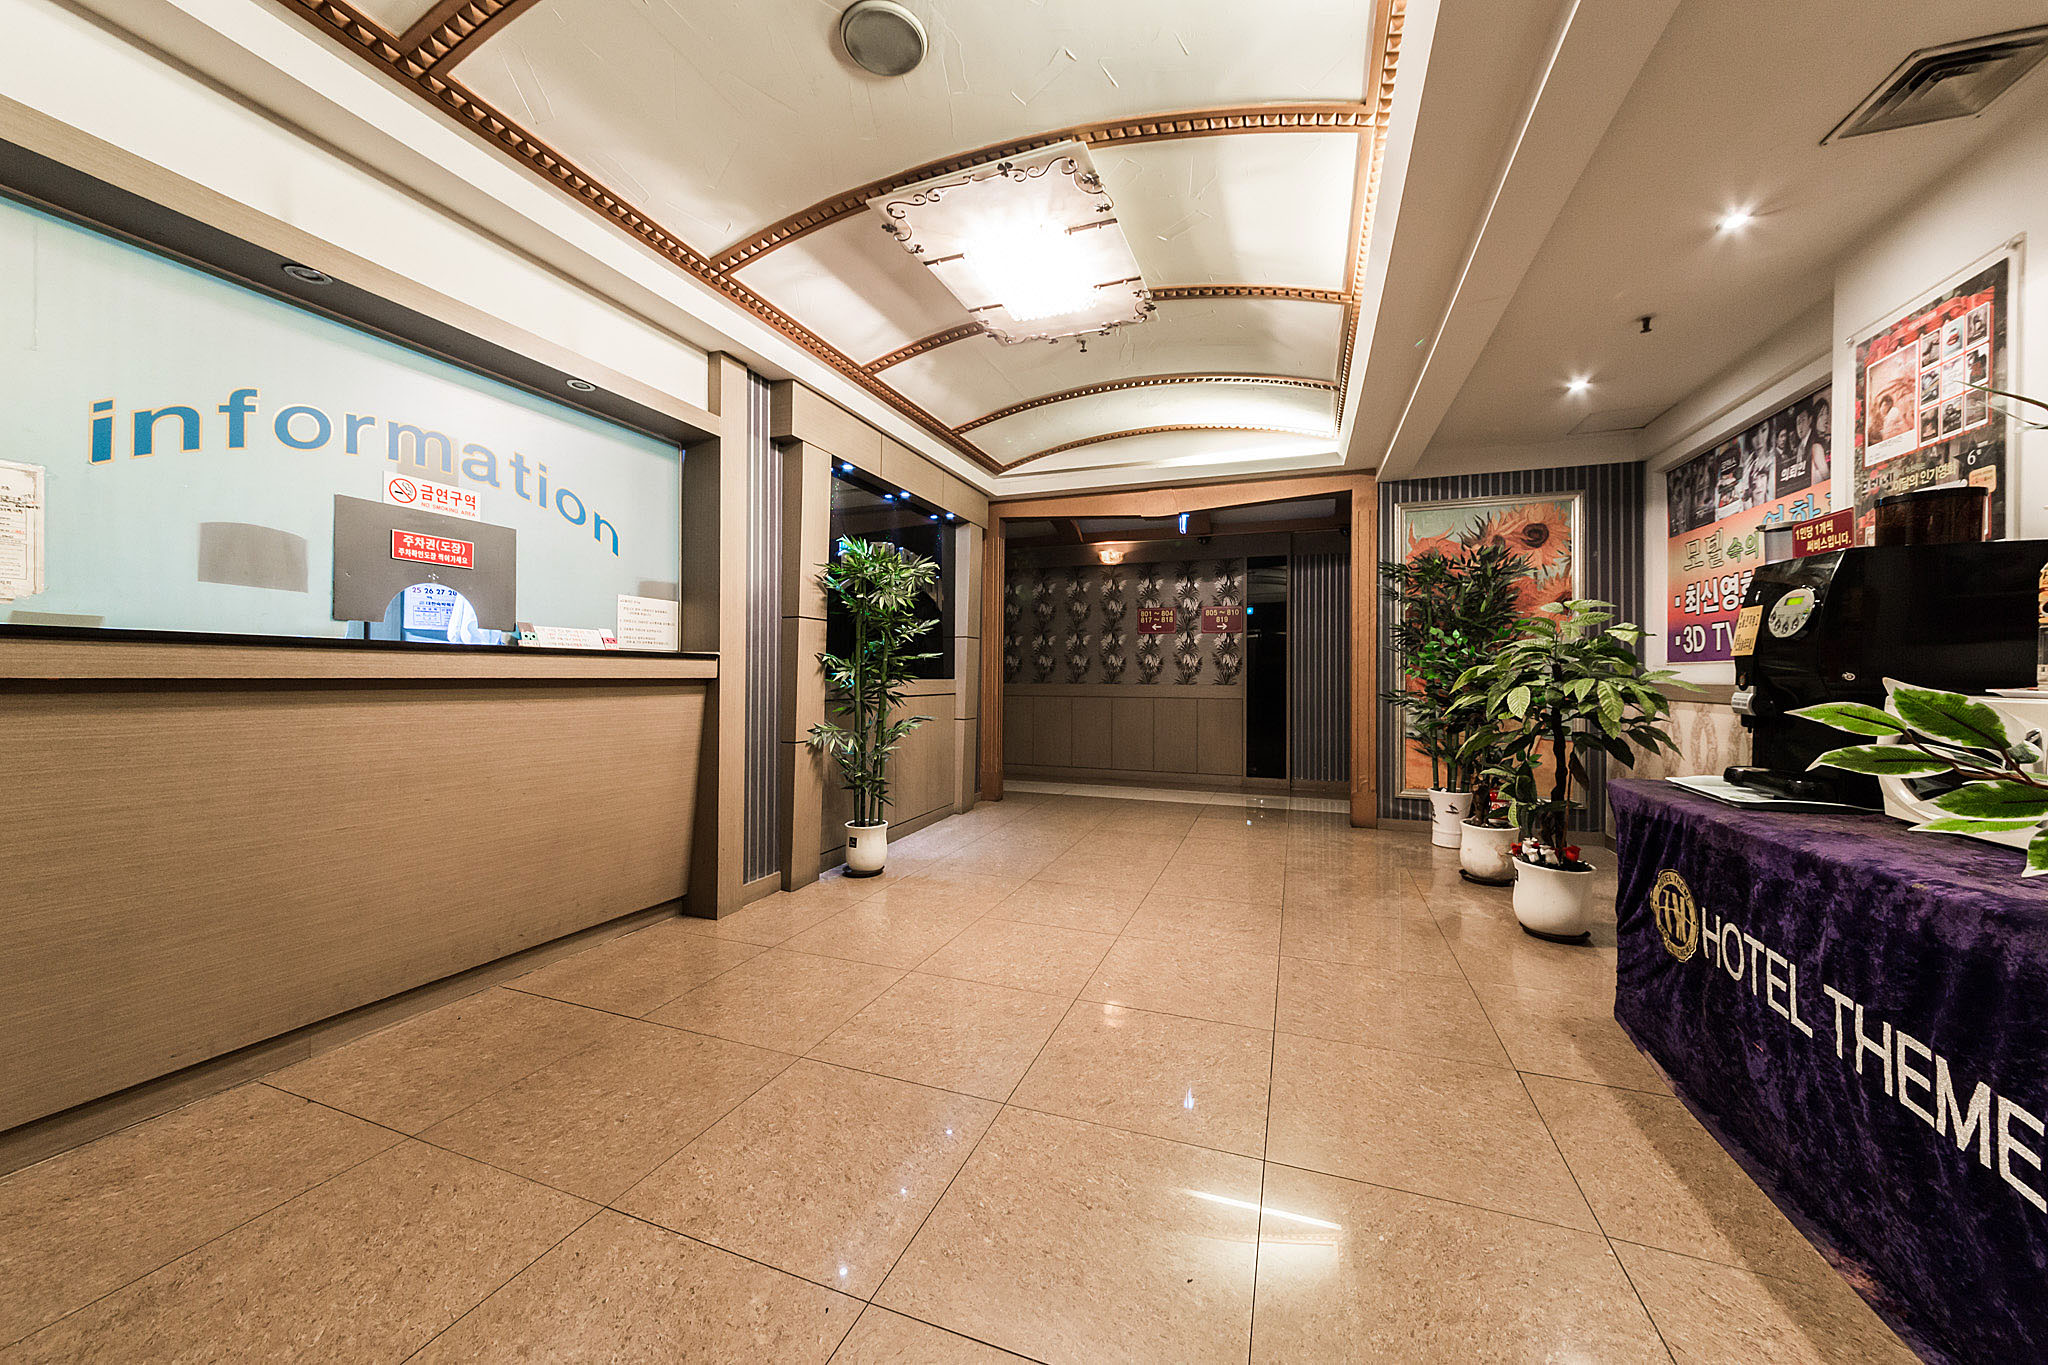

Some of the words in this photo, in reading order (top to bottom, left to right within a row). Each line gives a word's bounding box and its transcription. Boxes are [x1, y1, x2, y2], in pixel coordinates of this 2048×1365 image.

[88, 387, 622, 558] information
[420, 484, 476, 511] 금연구역
[432, 504, 459, 514] SMOKING
[461, 510, 476, 518] AREA
[403, 534, 466, 555] 주차권(도장)
[1683, 527, 1725, 572] 모텔
[1227, 608, 1240, 616] 810
[1682, 624, 1706, 654] 3D
[1702, 906, 1813, 1038] HOTEL
[1823, 983, 2048, 1214] THEME
